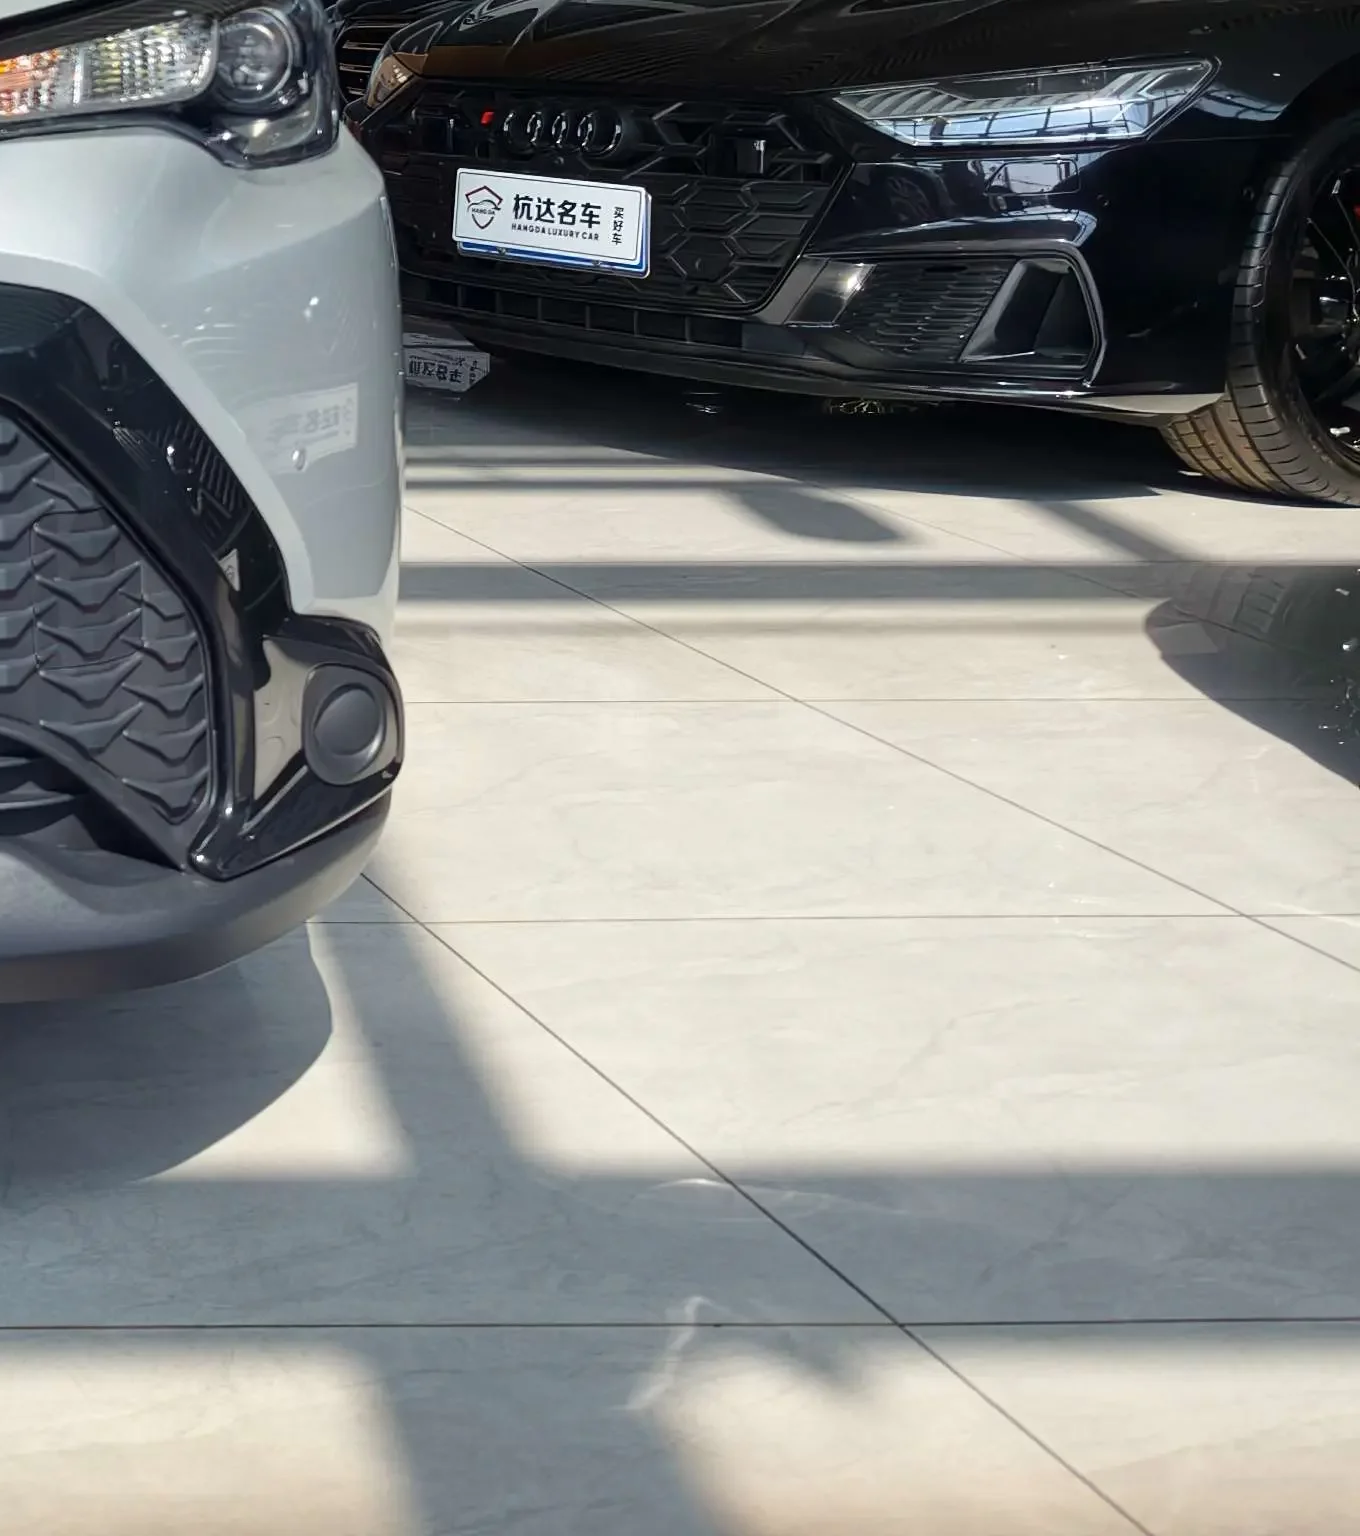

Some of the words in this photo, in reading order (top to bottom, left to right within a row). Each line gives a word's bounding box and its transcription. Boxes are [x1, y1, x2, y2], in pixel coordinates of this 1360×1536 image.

[511, 222, 546, 234] HANGDA
[547, 227, 580, 239] LUXURY
[581, 231, 600, 242] CAR
[512, 193, 602, 229] 杭达名车
[611, 206, 625, 246] 买好车
